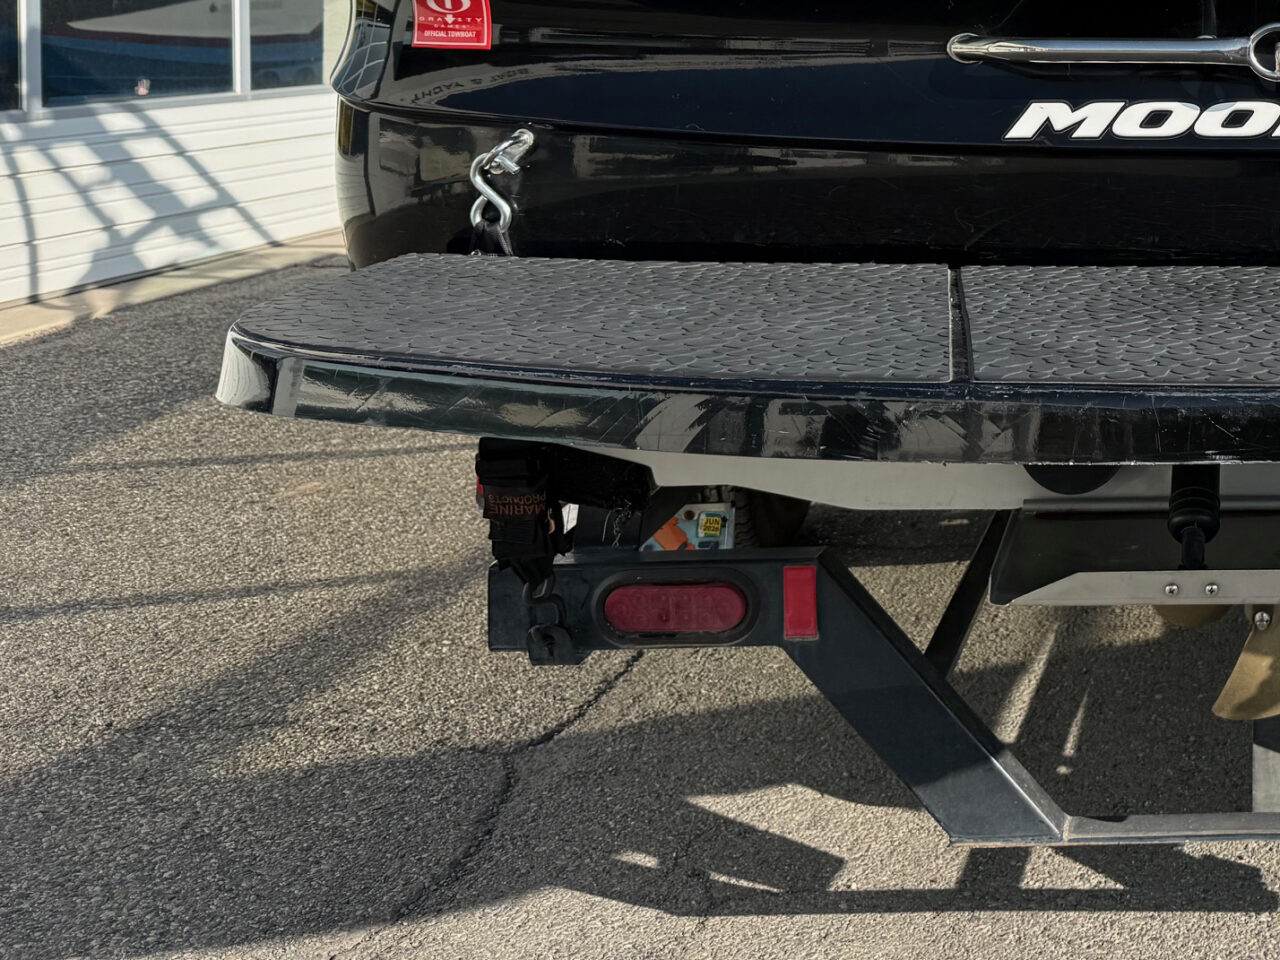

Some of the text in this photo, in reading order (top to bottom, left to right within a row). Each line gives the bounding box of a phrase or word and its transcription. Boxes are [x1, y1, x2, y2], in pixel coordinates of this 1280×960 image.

[448, 30, 477, 38] TOWBOAT
[488, 493, 546, 505] PRODUCTS
[489, 503, 545, 516] MARINE
